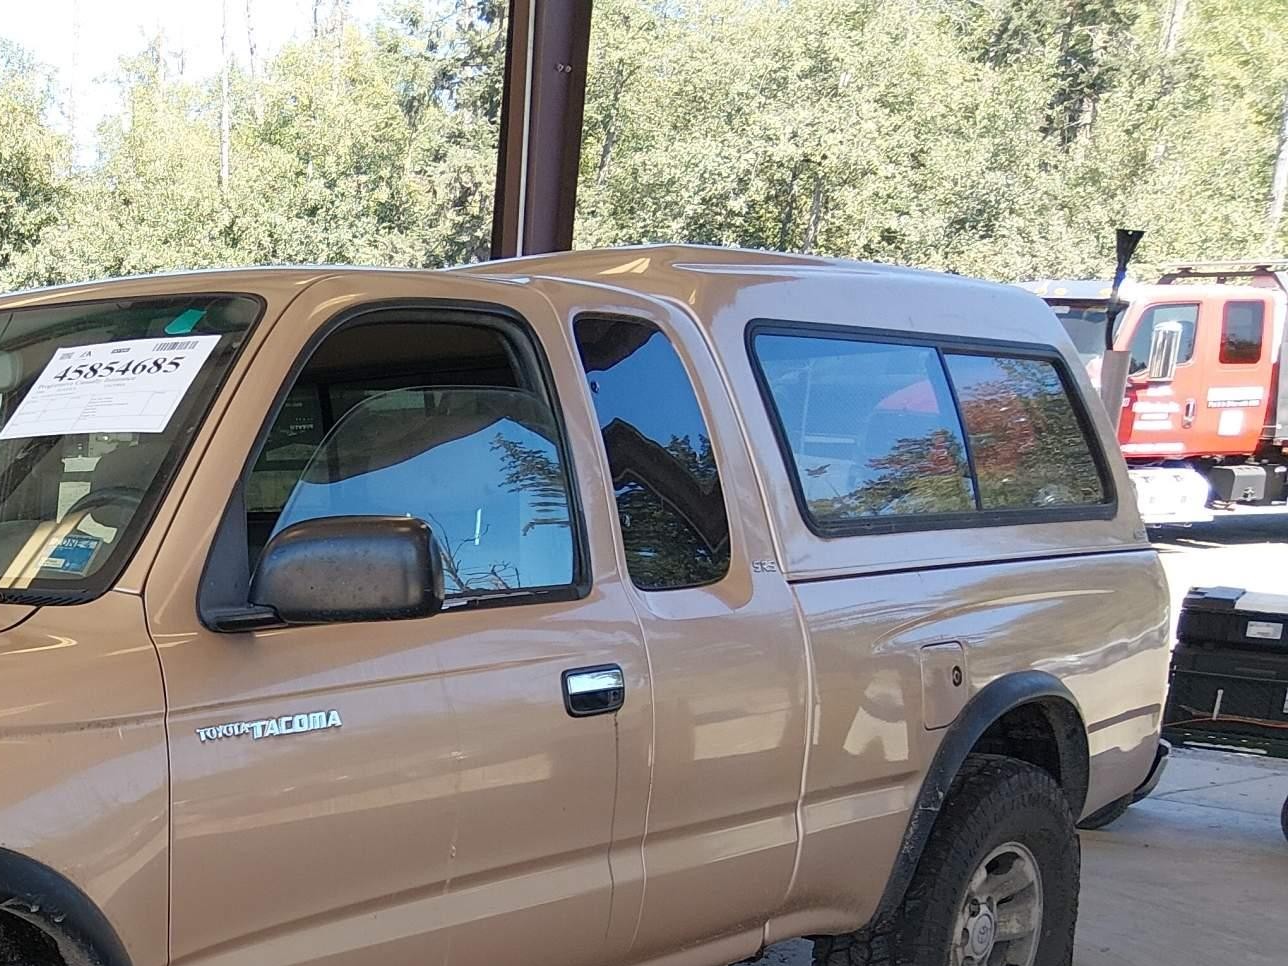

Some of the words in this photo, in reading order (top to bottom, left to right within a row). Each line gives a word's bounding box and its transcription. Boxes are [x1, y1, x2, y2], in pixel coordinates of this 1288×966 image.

[54, 356, 185, 382] 45854685
[196, 722, 250, 742] TOYOTA
[249, 710, 342, 739] TACOMA
